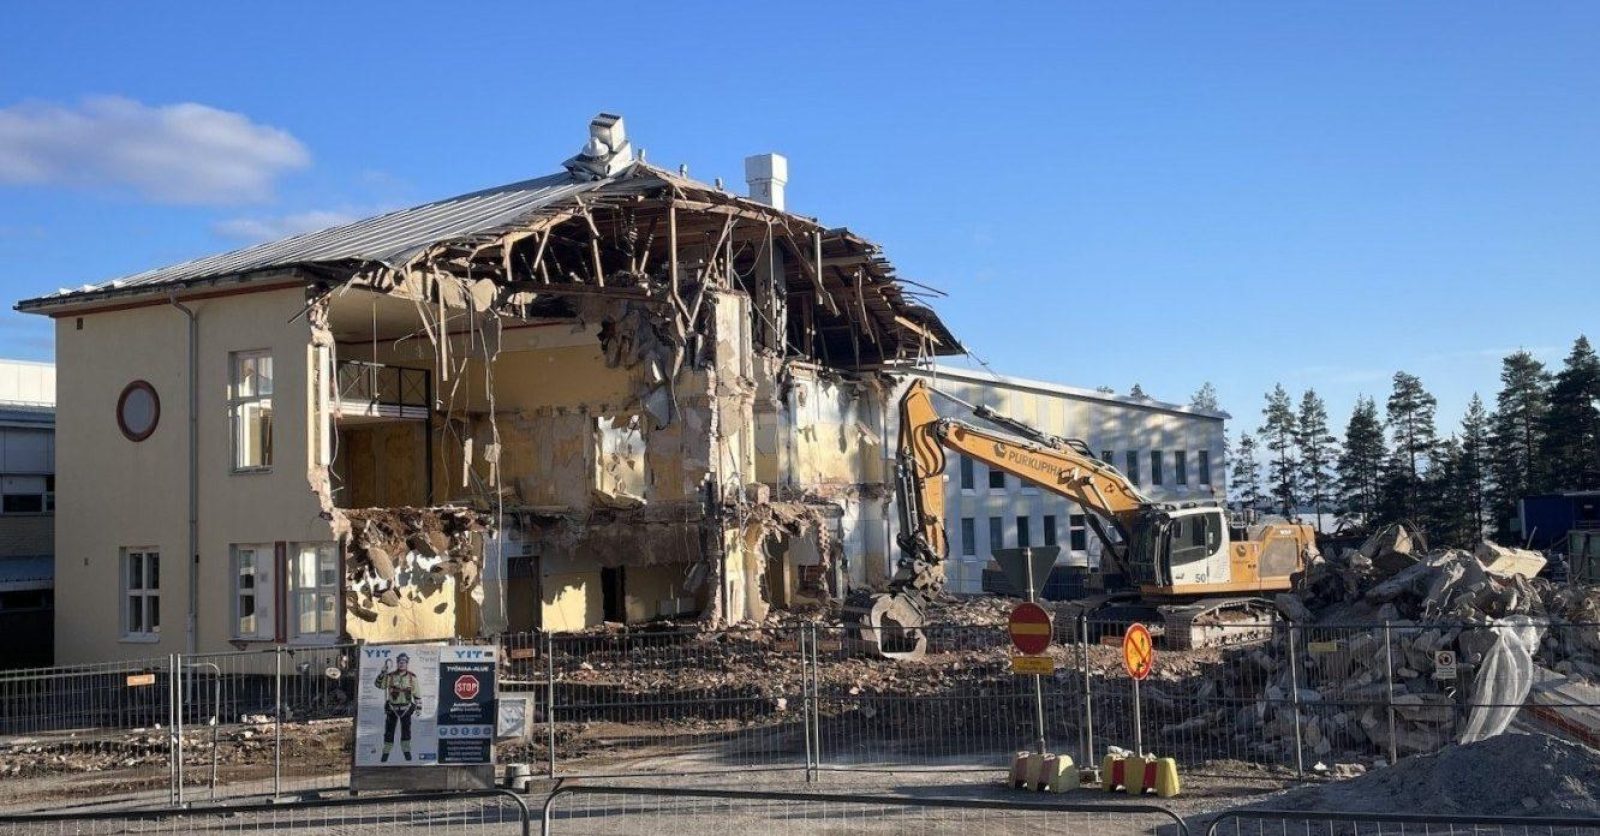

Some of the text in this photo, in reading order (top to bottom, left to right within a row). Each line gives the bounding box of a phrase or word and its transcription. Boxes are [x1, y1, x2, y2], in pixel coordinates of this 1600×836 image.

[1195, 573, 1206, 583] 50
[365, 649, 391, 658] YIT
[455, 650, 482, 658] YIT
[457, 682, 477, 692] STOP
